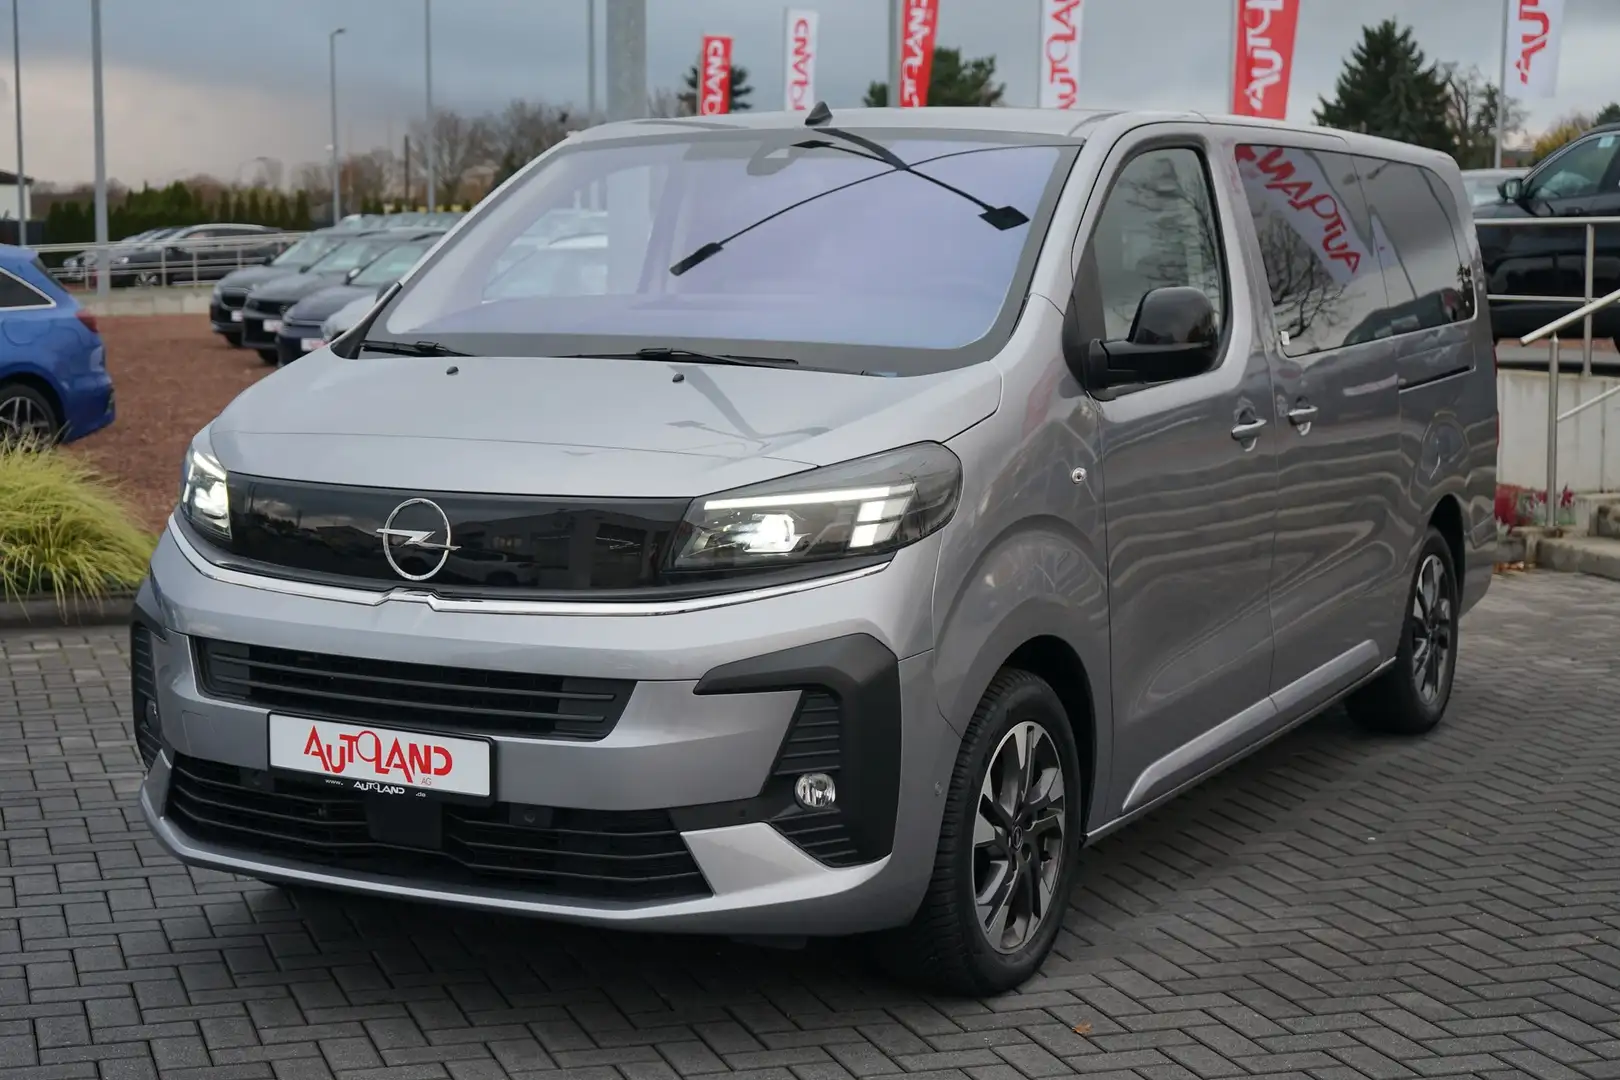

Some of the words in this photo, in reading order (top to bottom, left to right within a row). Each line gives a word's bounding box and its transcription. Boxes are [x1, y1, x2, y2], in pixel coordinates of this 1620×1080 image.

[304, 725, 453, 784] AUTOLAND
[353, 781, 405, 795] AUTOLAND
[421, 777, 432, 787] AG
